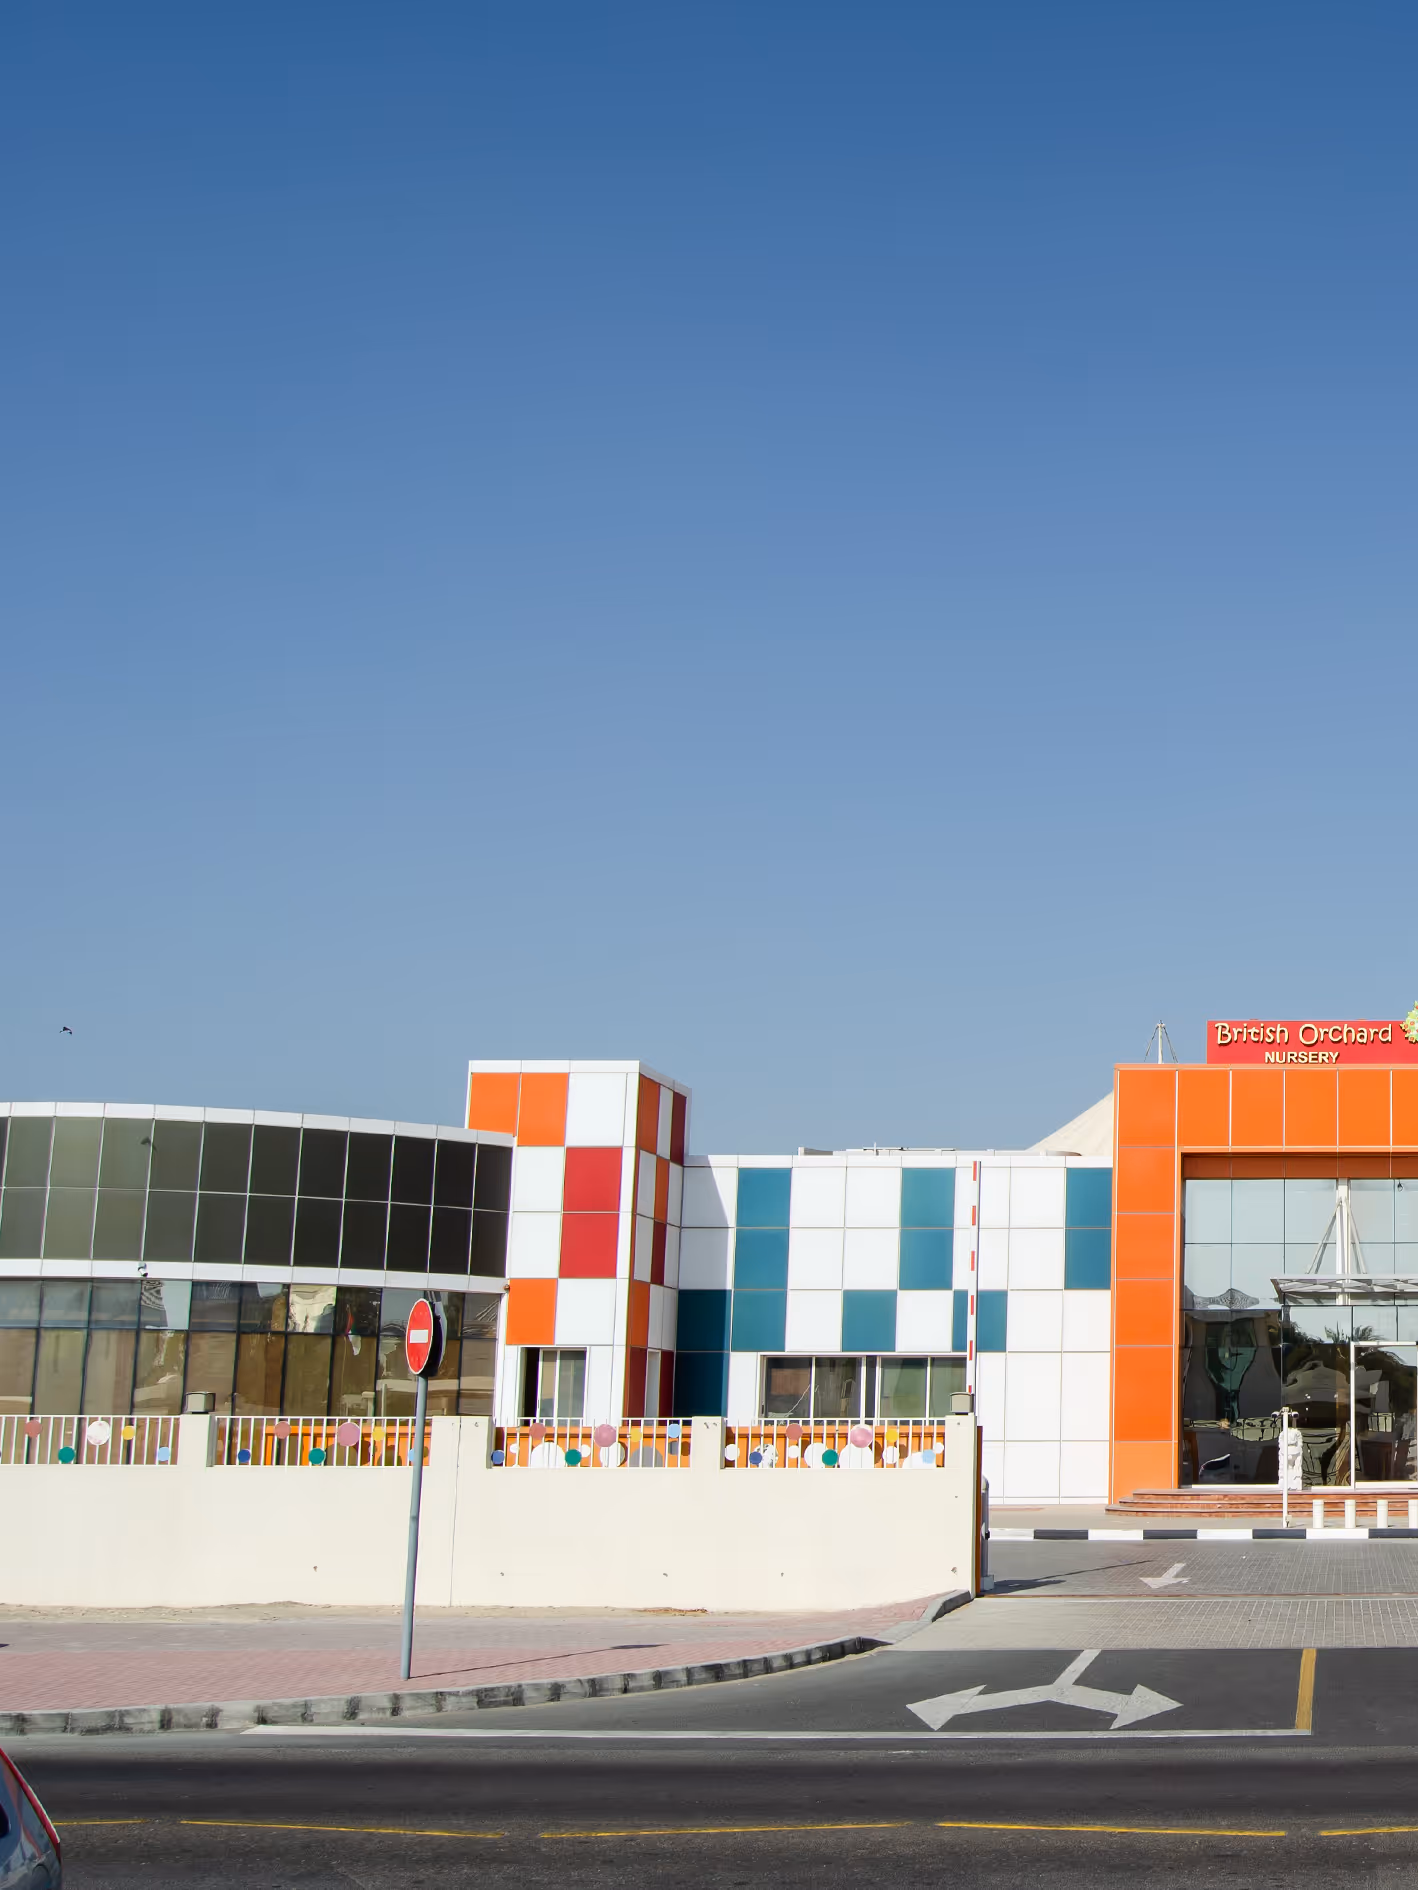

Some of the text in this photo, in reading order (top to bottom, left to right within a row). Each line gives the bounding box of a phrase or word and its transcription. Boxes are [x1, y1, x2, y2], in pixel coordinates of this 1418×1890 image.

[1214, 1023, 1393, 1045] British Orchard
[1264, 1051, 1340, 1064] NURSERY
